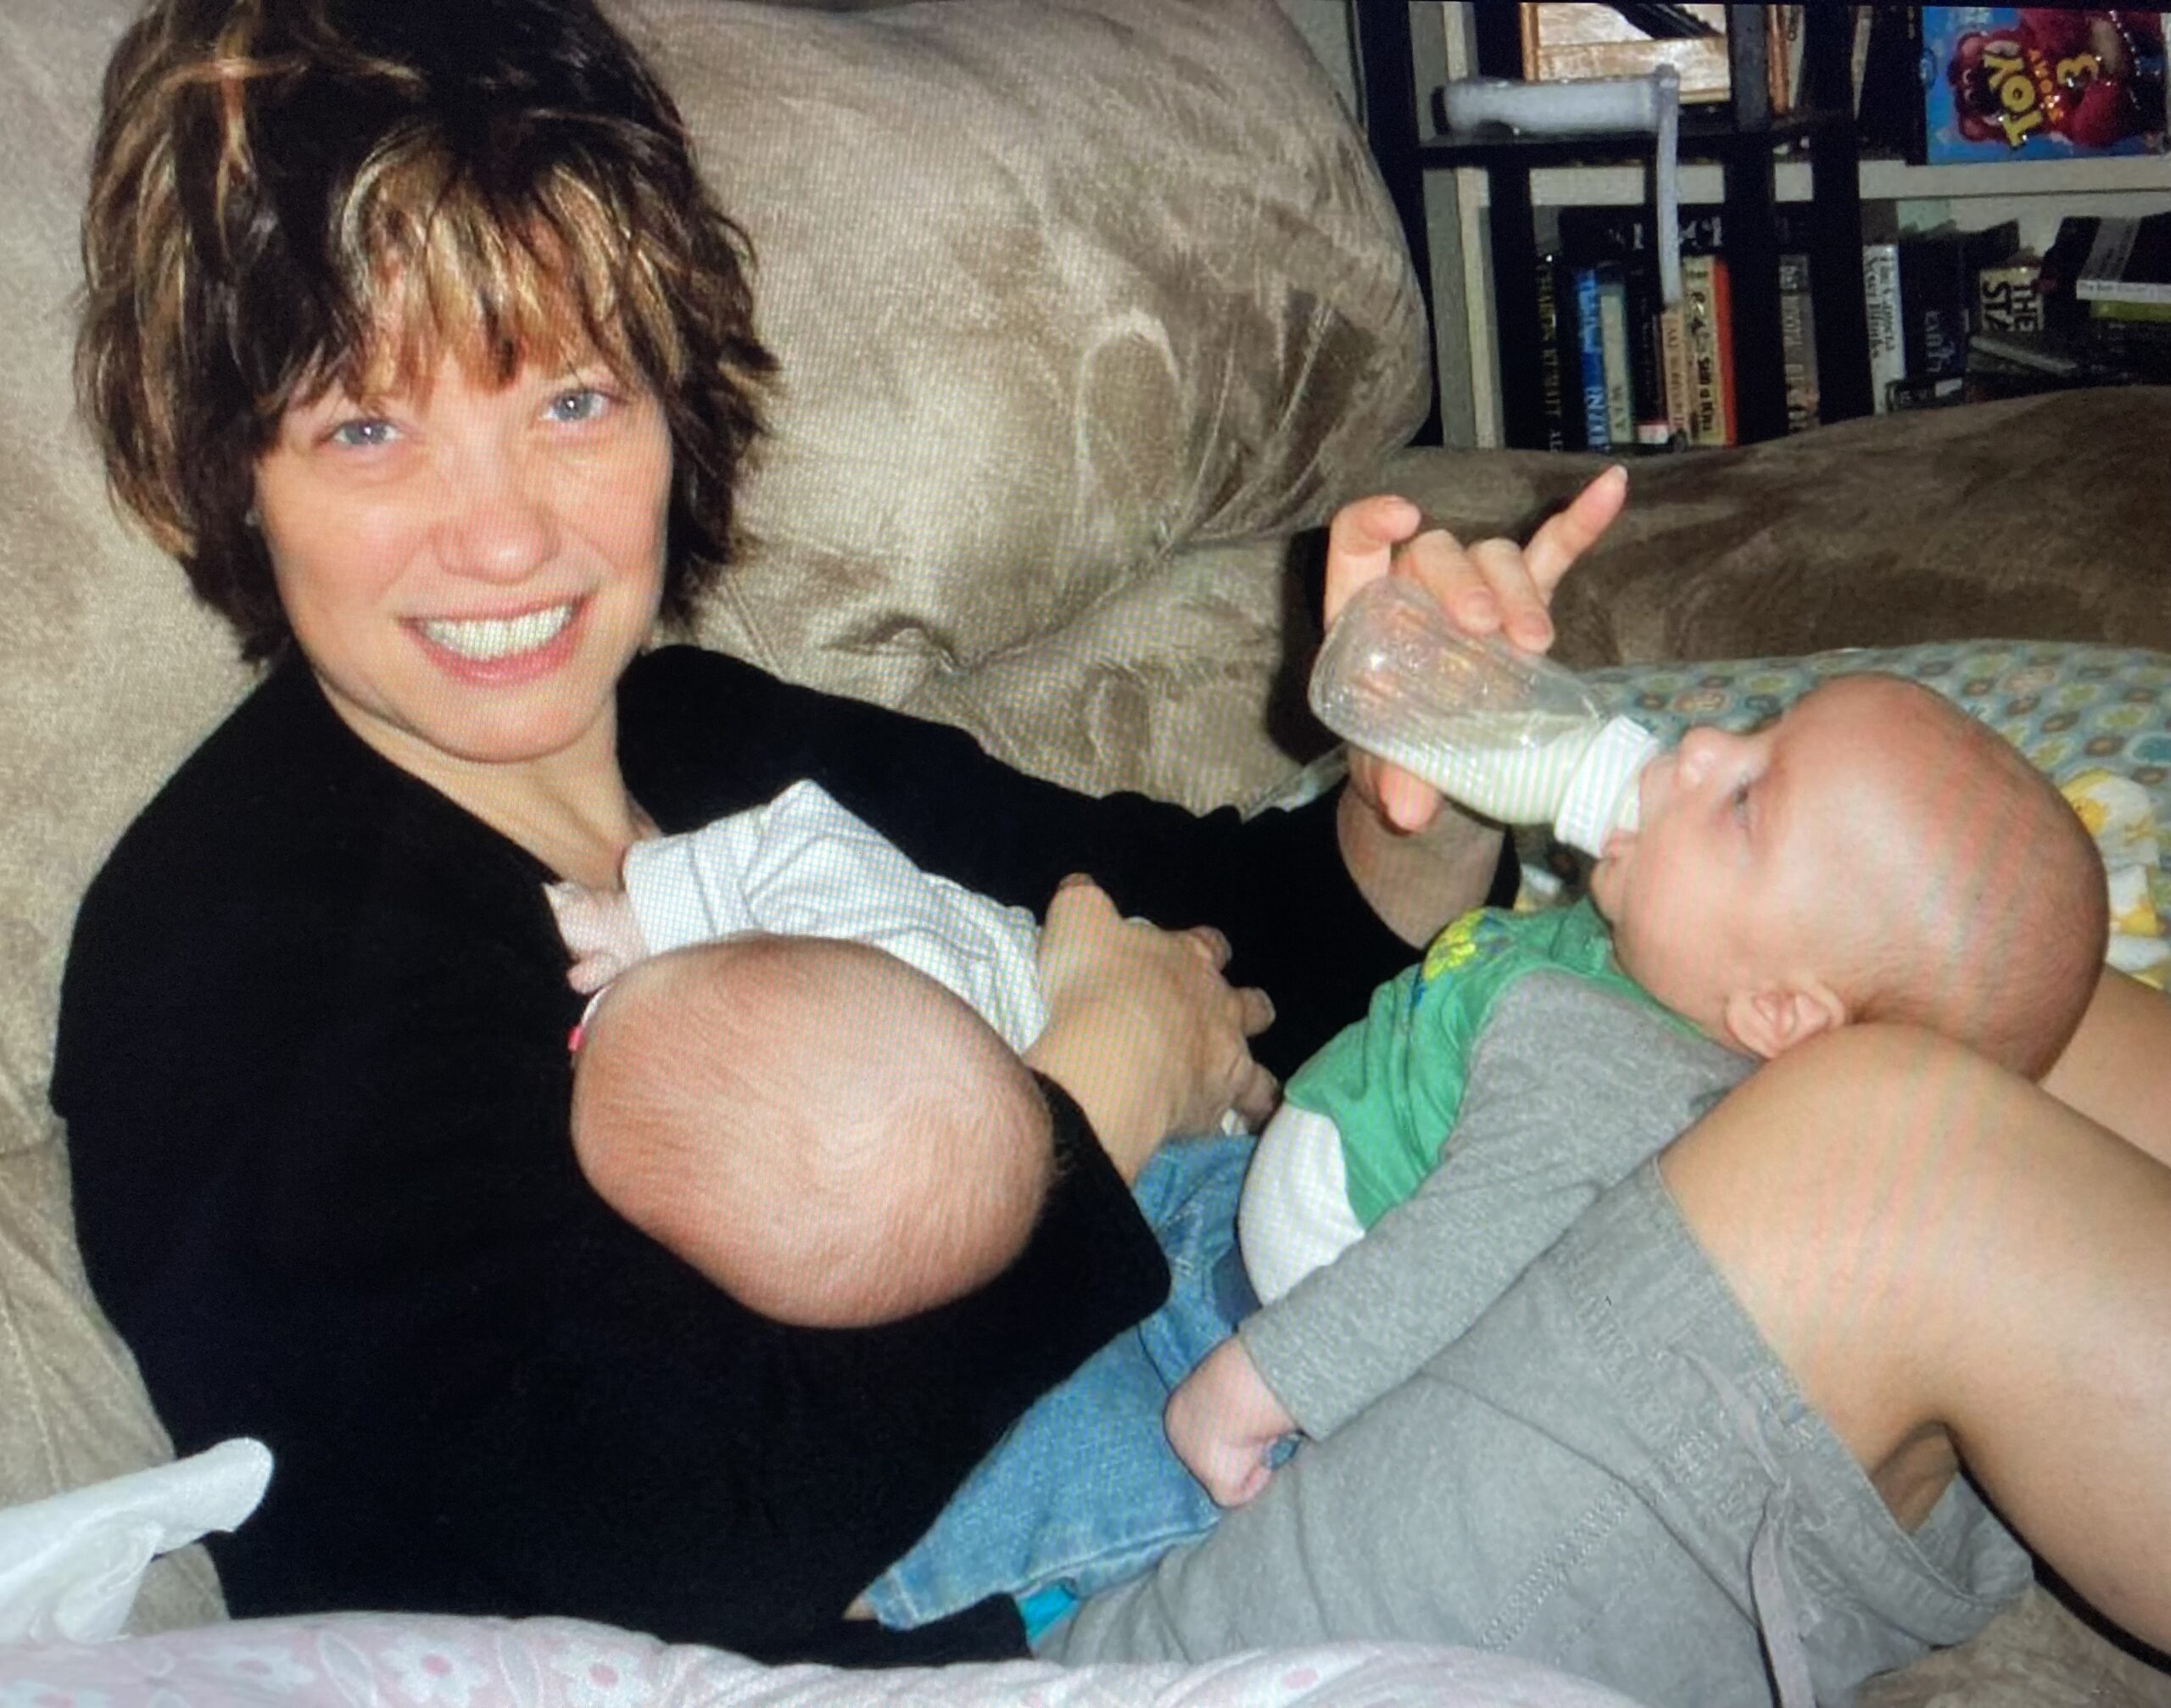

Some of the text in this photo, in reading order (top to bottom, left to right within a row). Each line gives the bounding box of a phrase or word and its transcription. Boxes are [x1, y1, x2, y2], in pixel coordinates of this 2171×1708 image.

[1983, 53, 2044, 149] TOY
[2028, 48, 2064, 123] ORY
[2057, 53, 2099, 87] 3
